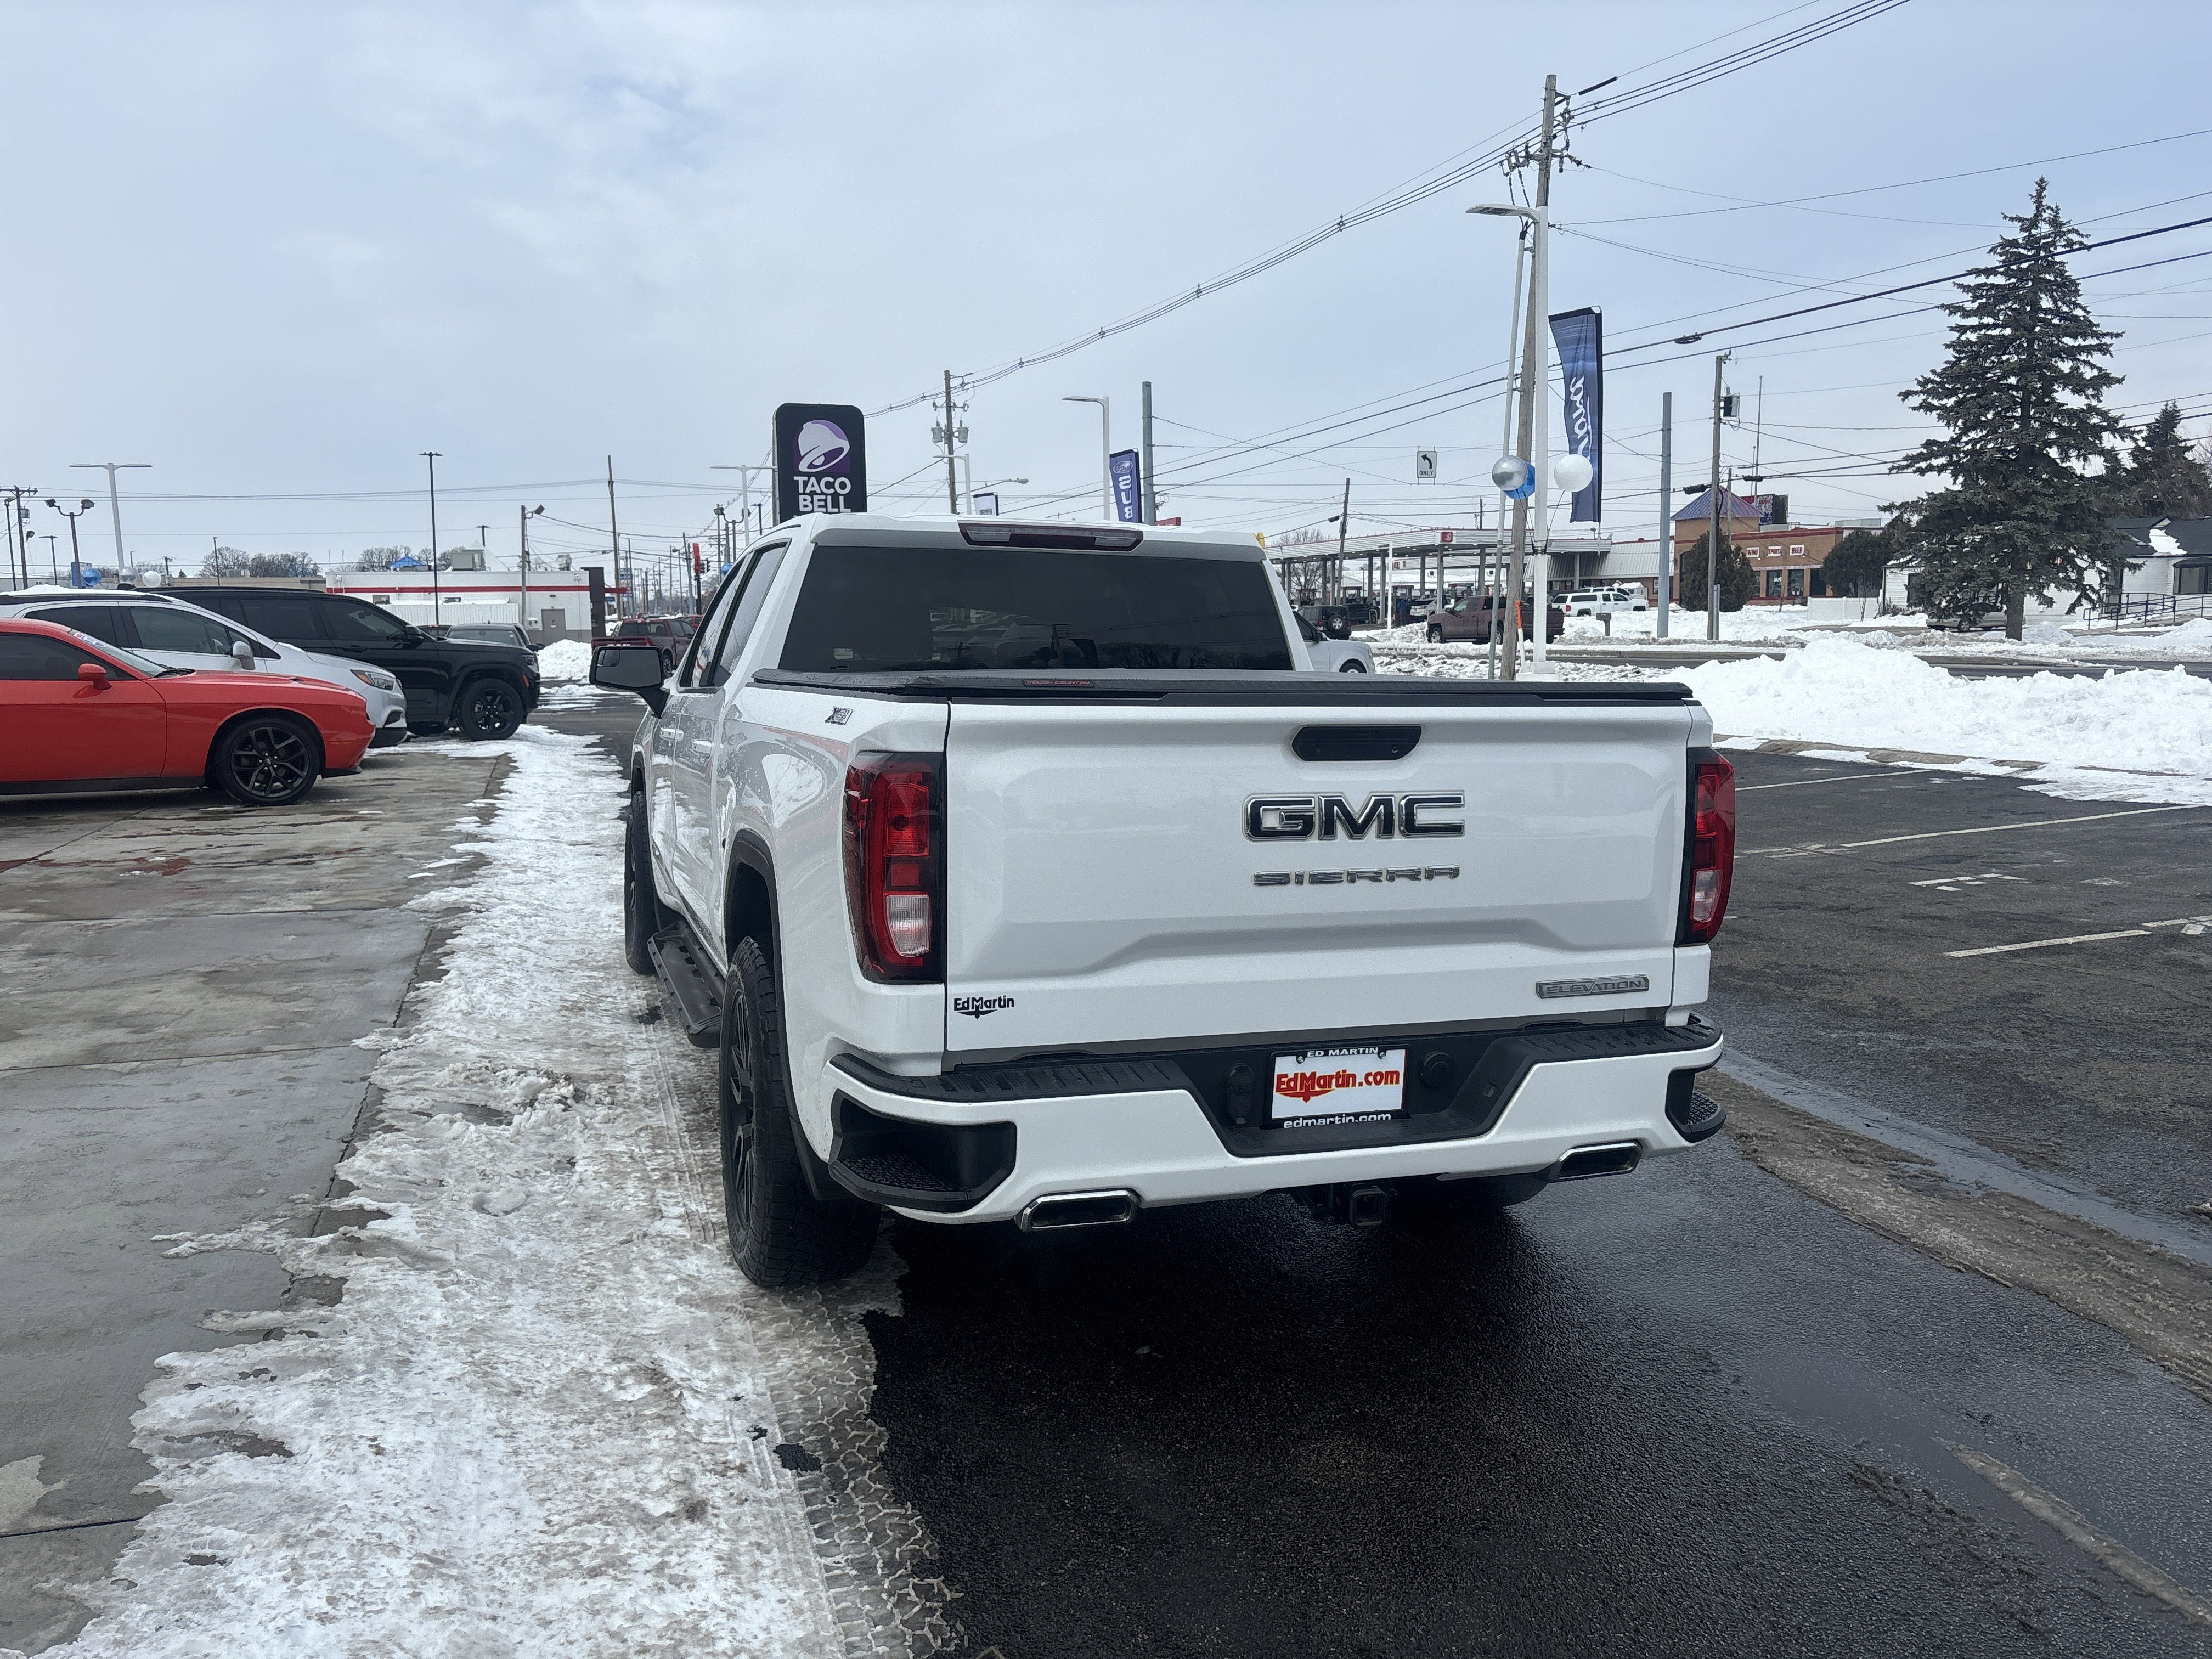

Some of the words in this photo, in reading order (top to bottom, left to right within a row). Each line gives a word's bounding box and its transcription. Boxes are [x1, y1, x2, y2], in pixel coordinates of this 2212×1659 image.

[793, 476, 851, 494] TACO
[799, 495, 851, 513] BELL
[1243, 792, 1465, 841] GMC
[1254, 864, 1460, 886] SIERRA
[1547, 980, 1641, 994] ELEVATION
[954, 995, 1014, 1011] EdMartin
[1328, 1047, 1378, 1056] MARTIN
[1276, 1069, 1400, 1093] EdMartin.com
[1284, 1114, 1391, 1128] edmartin.com
